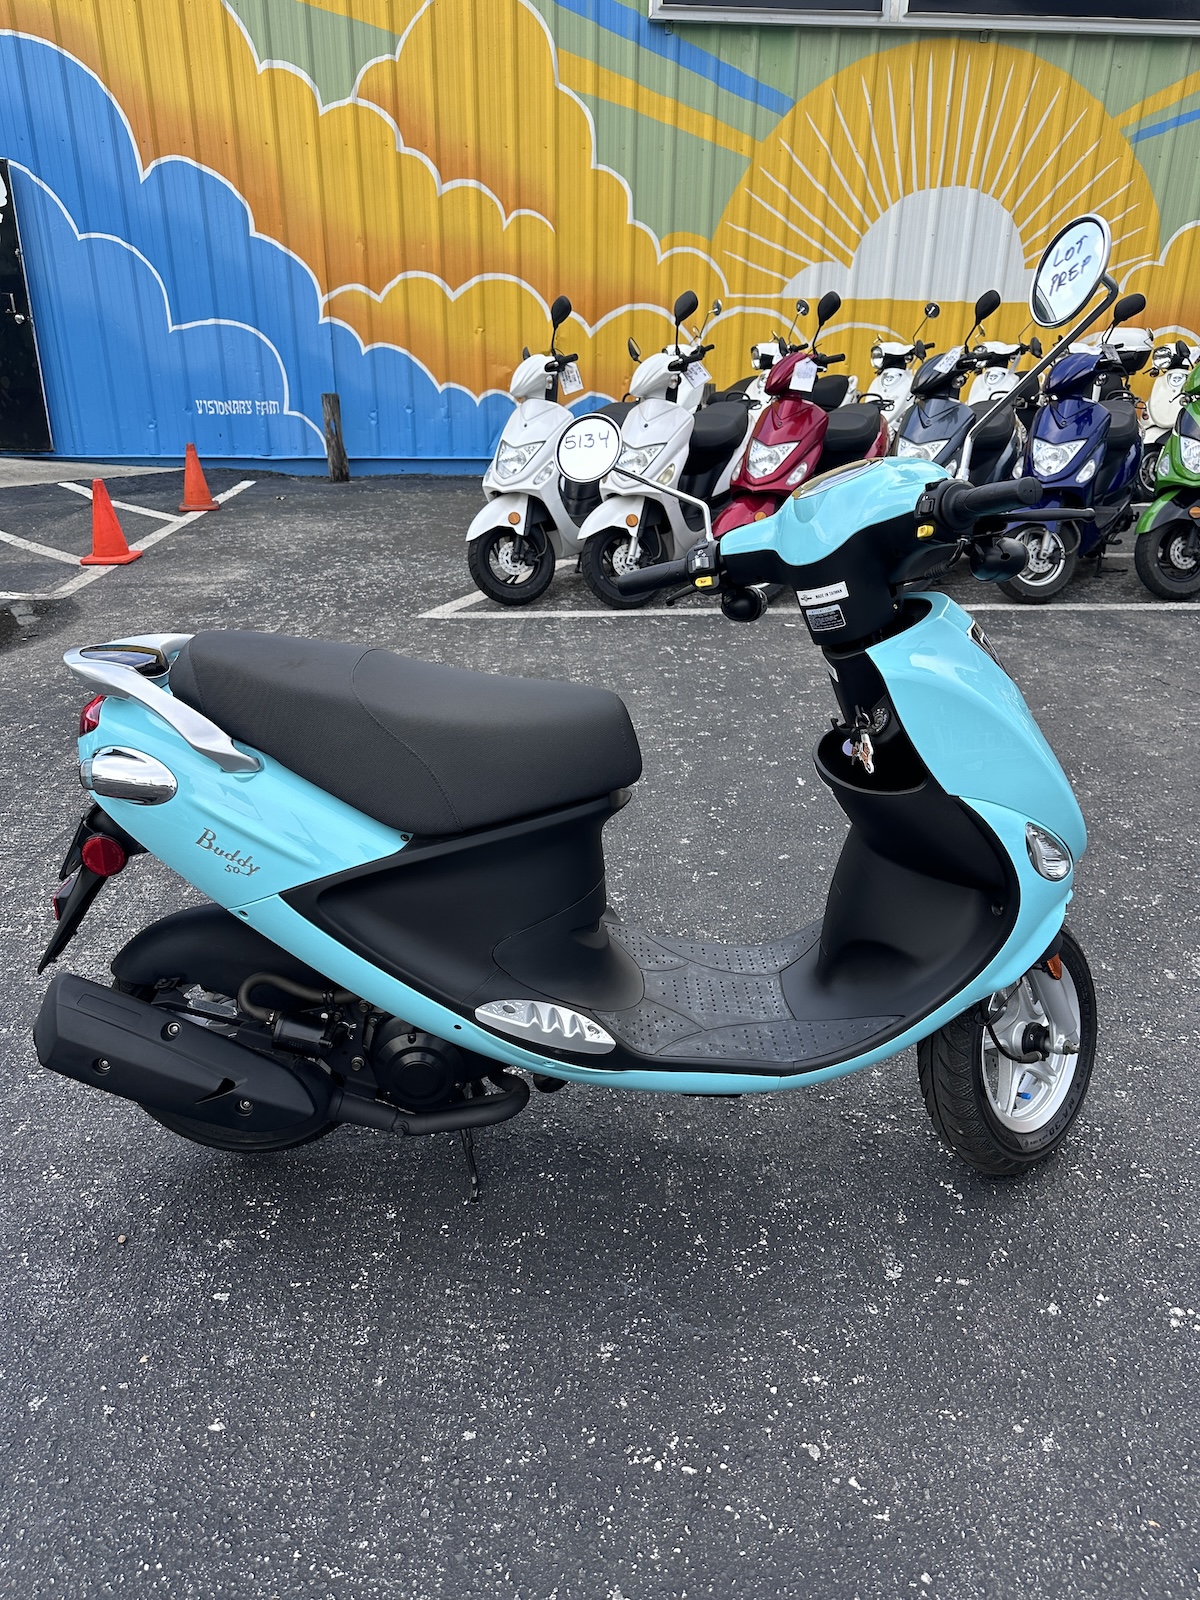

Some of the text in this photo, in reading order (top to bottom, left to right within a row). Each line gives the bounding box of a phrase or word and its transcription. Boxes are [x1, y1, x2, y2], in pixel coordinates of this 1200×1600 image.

[1053, 234, 1088, 267] LOT
[1049, 255, 1092, 297] PREP
[195, 399, 280, 416] VISIONARY FAM
[564, 430, 610, 450] 5134
[195, 827, 261, 877] Buddy
[224, 864, 240, 874] 50
